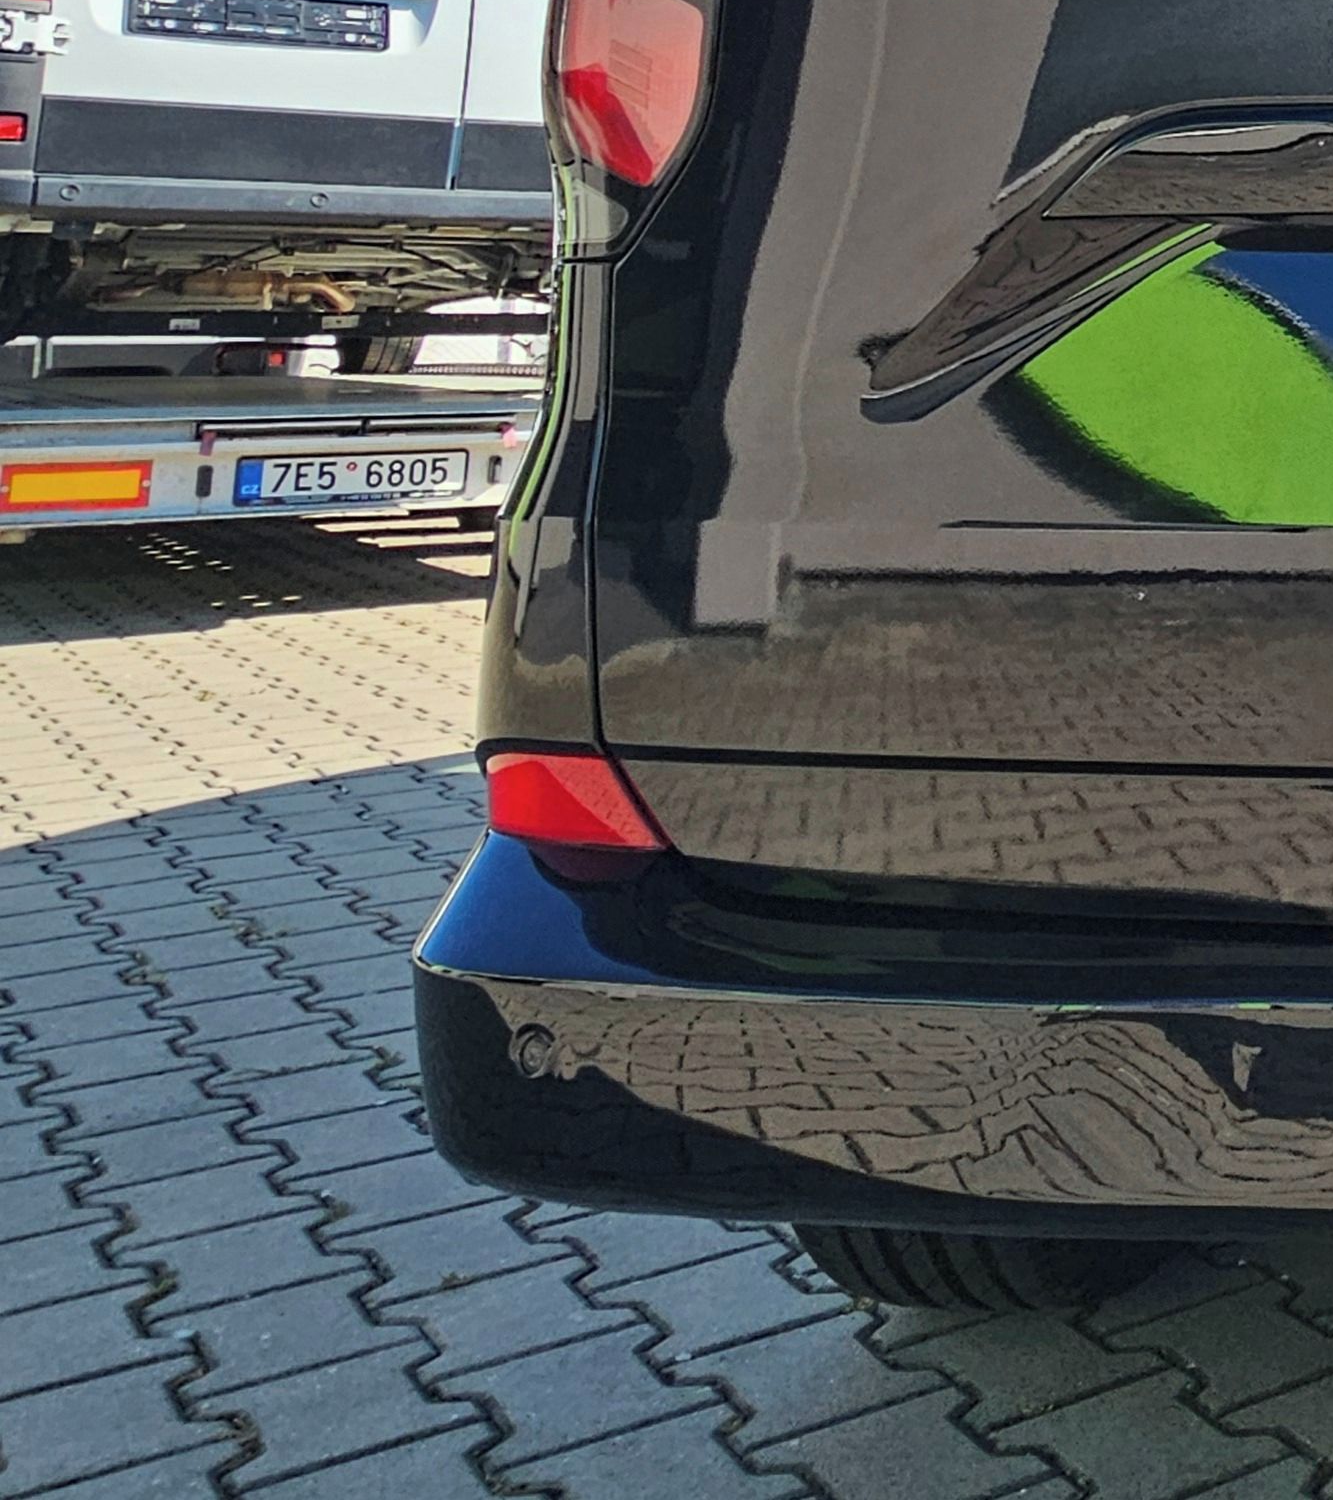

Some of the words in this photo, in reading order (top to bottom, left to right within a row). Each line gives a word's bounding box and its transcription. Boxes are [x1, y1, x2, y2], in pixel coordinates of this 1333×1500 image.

[270, 461, 338, 493] 7E5
[365, 458, 449, 488] 6805
[241, 484, 260, 495] CZ
